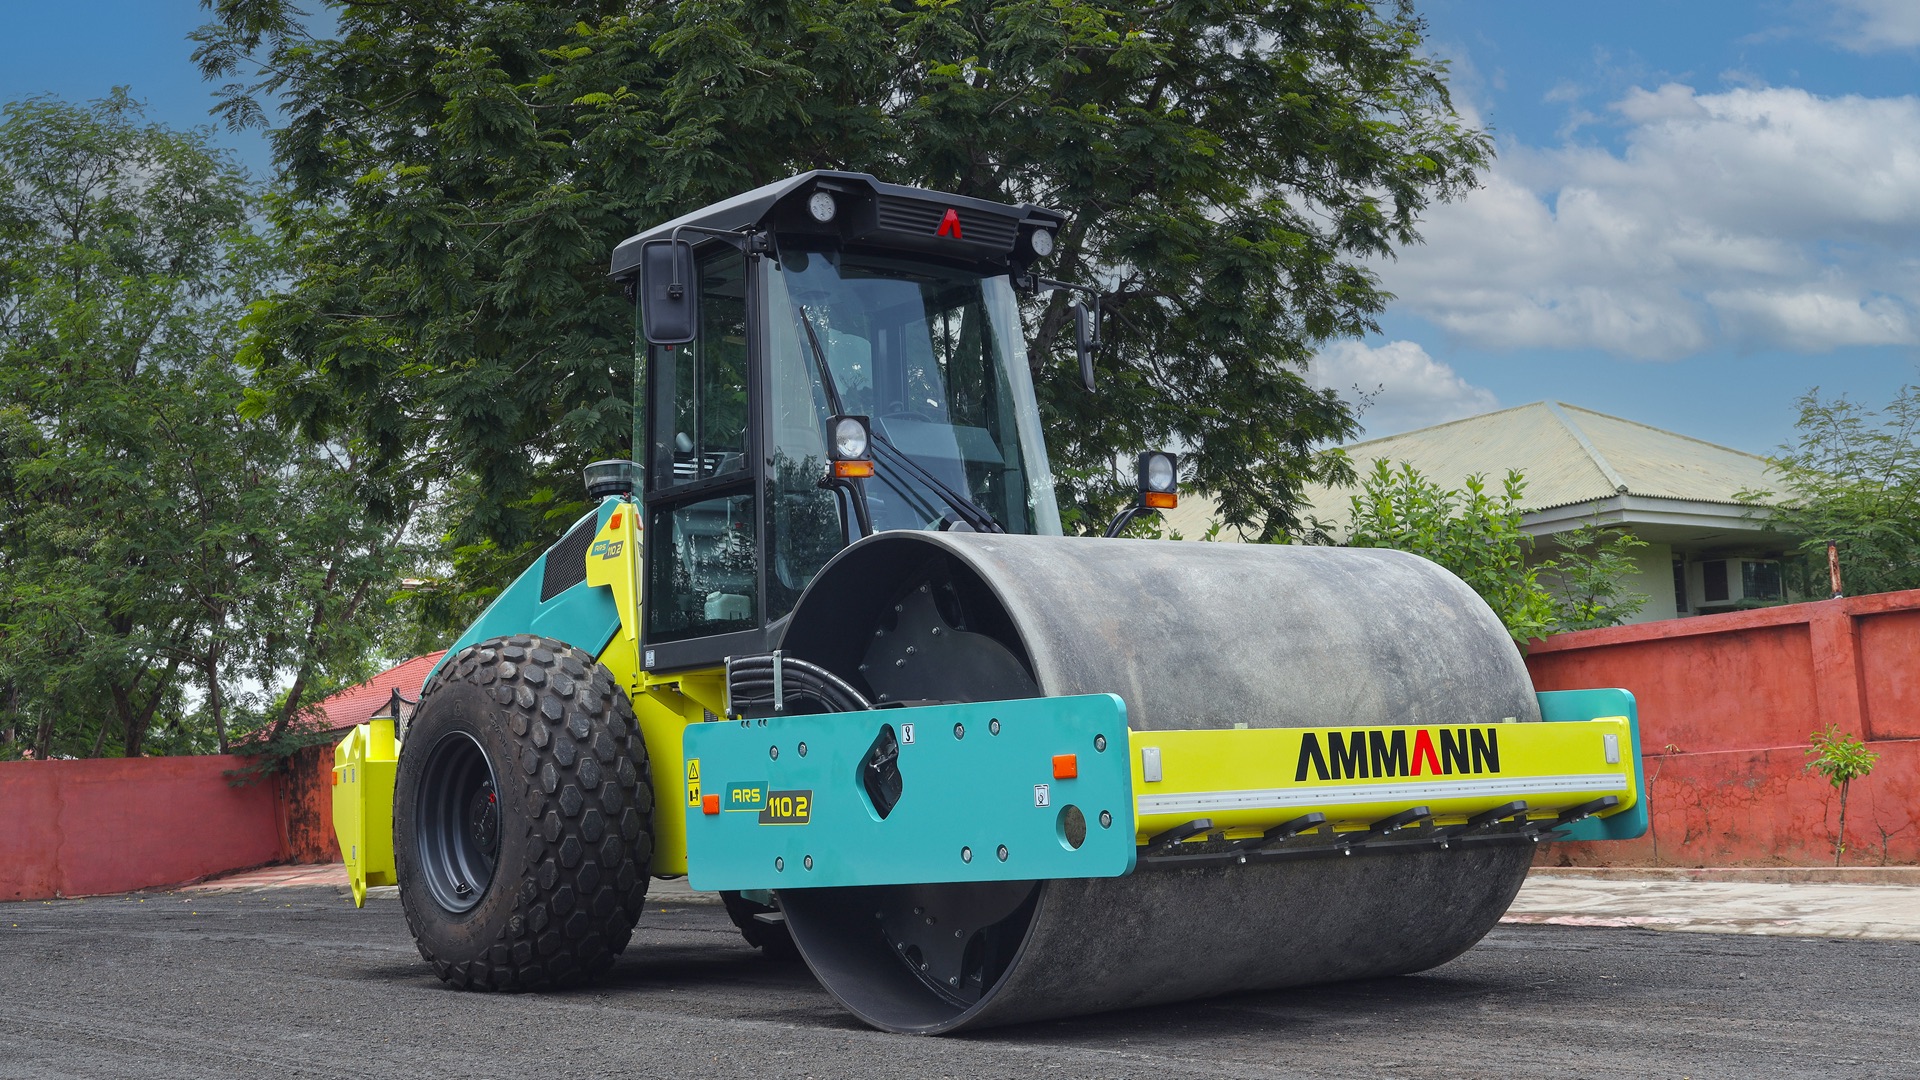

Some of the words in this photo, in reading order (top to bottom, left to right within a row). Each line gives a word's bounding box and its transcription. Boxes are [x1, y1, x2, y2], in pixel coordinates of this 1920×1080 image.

[1294, 728, 1501, 782] AMMANN
[732, 788, 761, 803] ARS
[769, 796, 808, 818] 110.2
